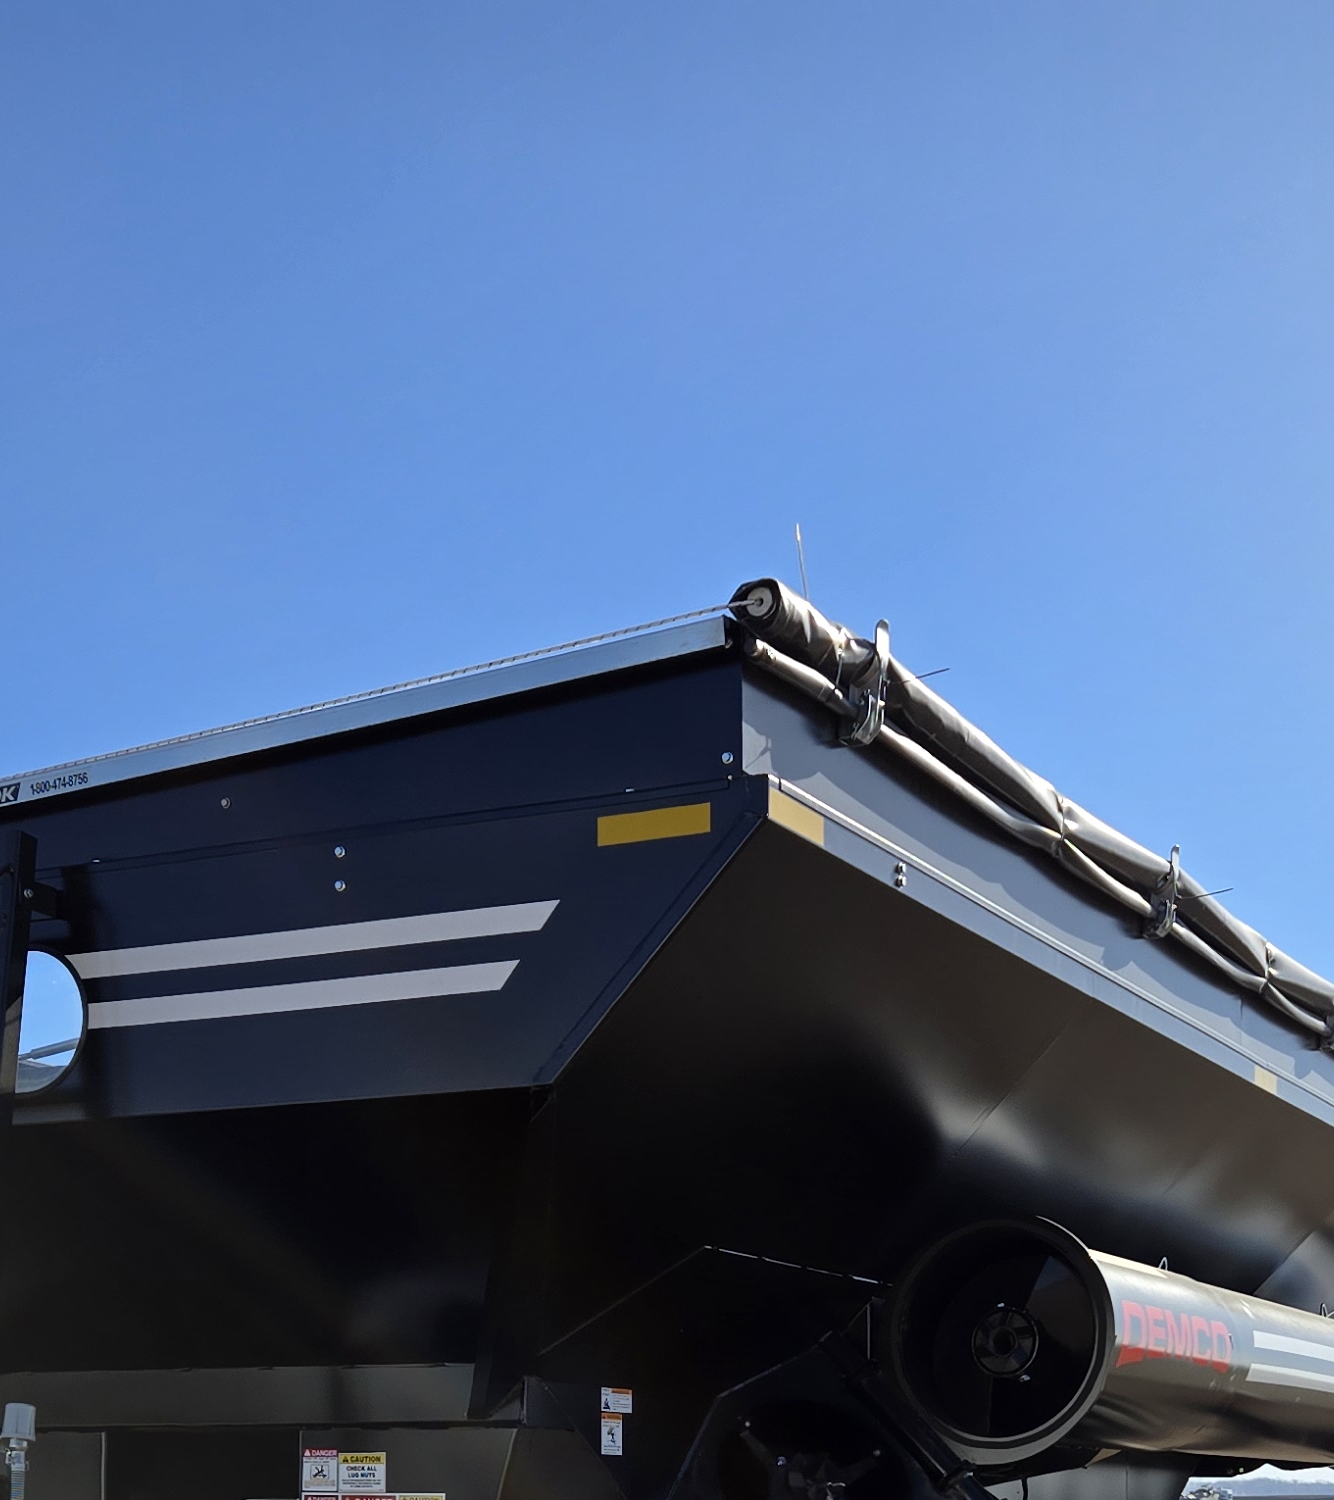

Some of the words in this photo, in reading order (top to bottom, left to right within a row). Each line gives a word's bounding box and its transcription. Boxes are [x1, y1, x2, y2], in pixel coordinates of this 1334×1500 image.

[30, 772, 88, 796] 1-800-474-8756
[1115, 1299, 1233, 1373] DEMCO
[311, 1449, 337, 1457] DANGER
[349, 1455, 381, 1463] CAUTION
